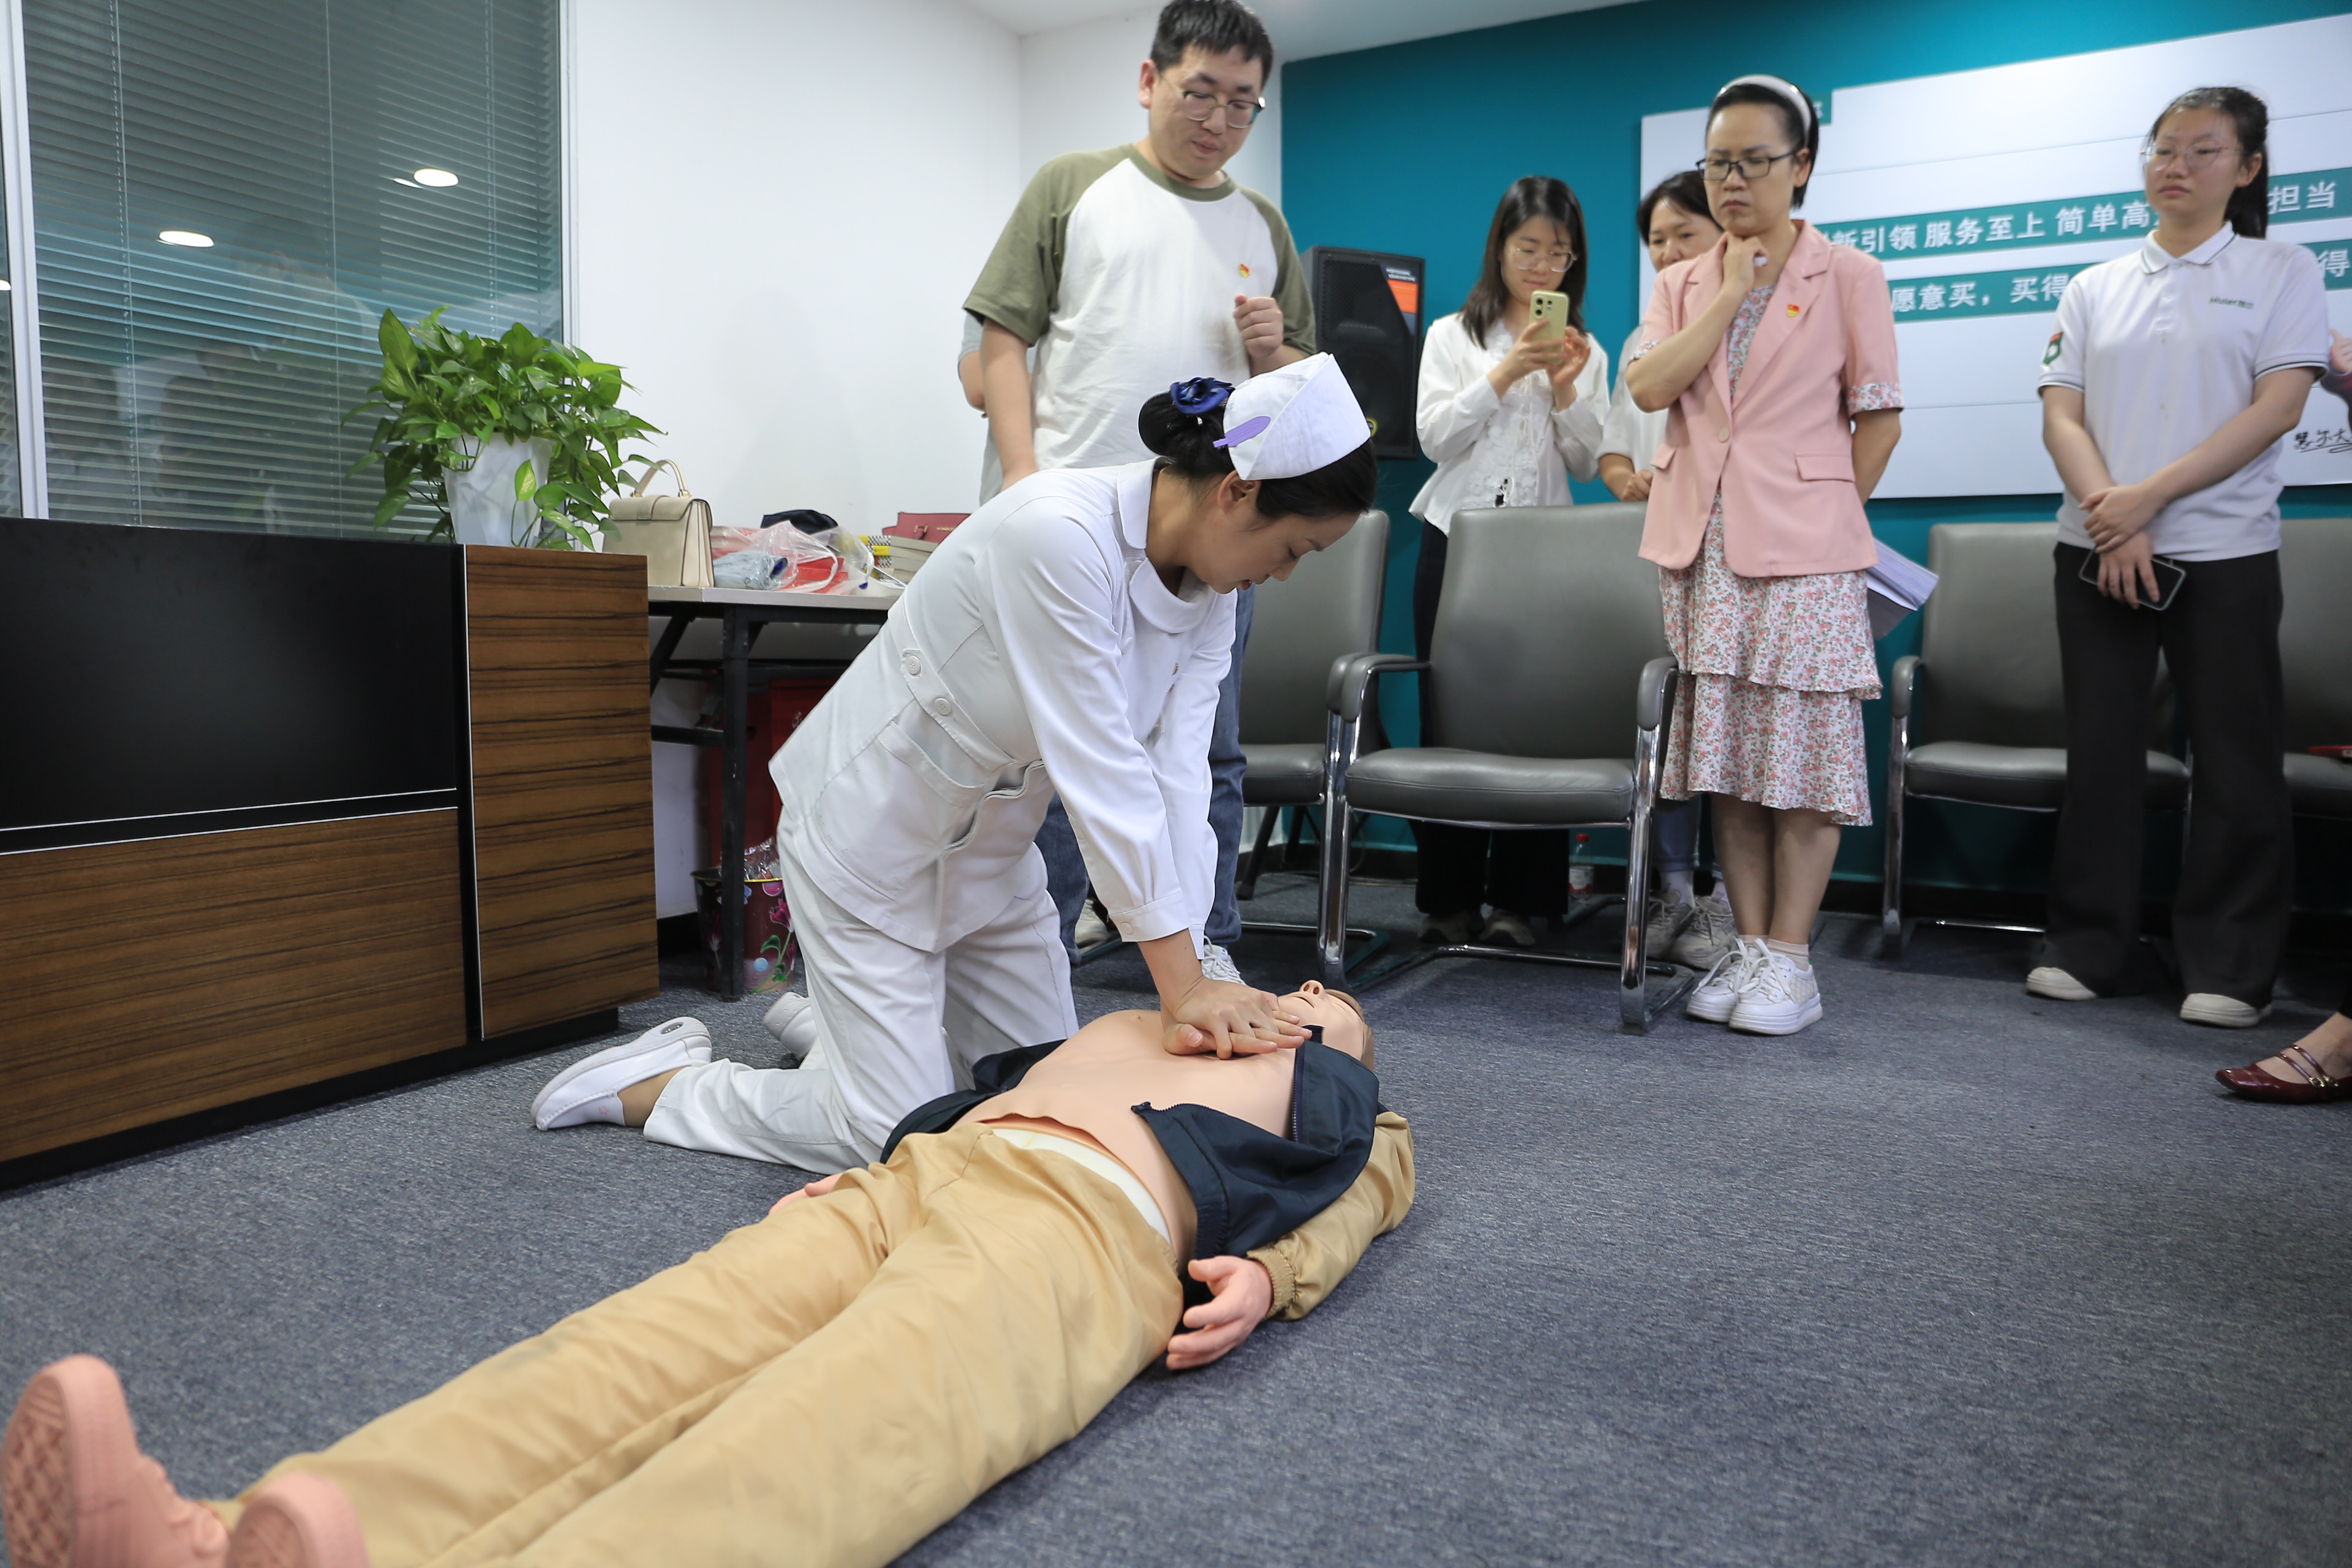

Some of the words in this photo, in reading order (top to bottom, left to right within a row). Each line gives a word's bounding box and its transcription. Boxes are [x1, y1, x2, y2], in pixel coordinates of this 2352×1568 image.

[1823, 224, 1918, 253] 新引领
[1923, 211, 2046, 249] 服务至上
[2055, 199, 2160, 236] 简单高
[2267, 180, 2337, 214] 担当
[2318, 249, 2351, 277] 得
